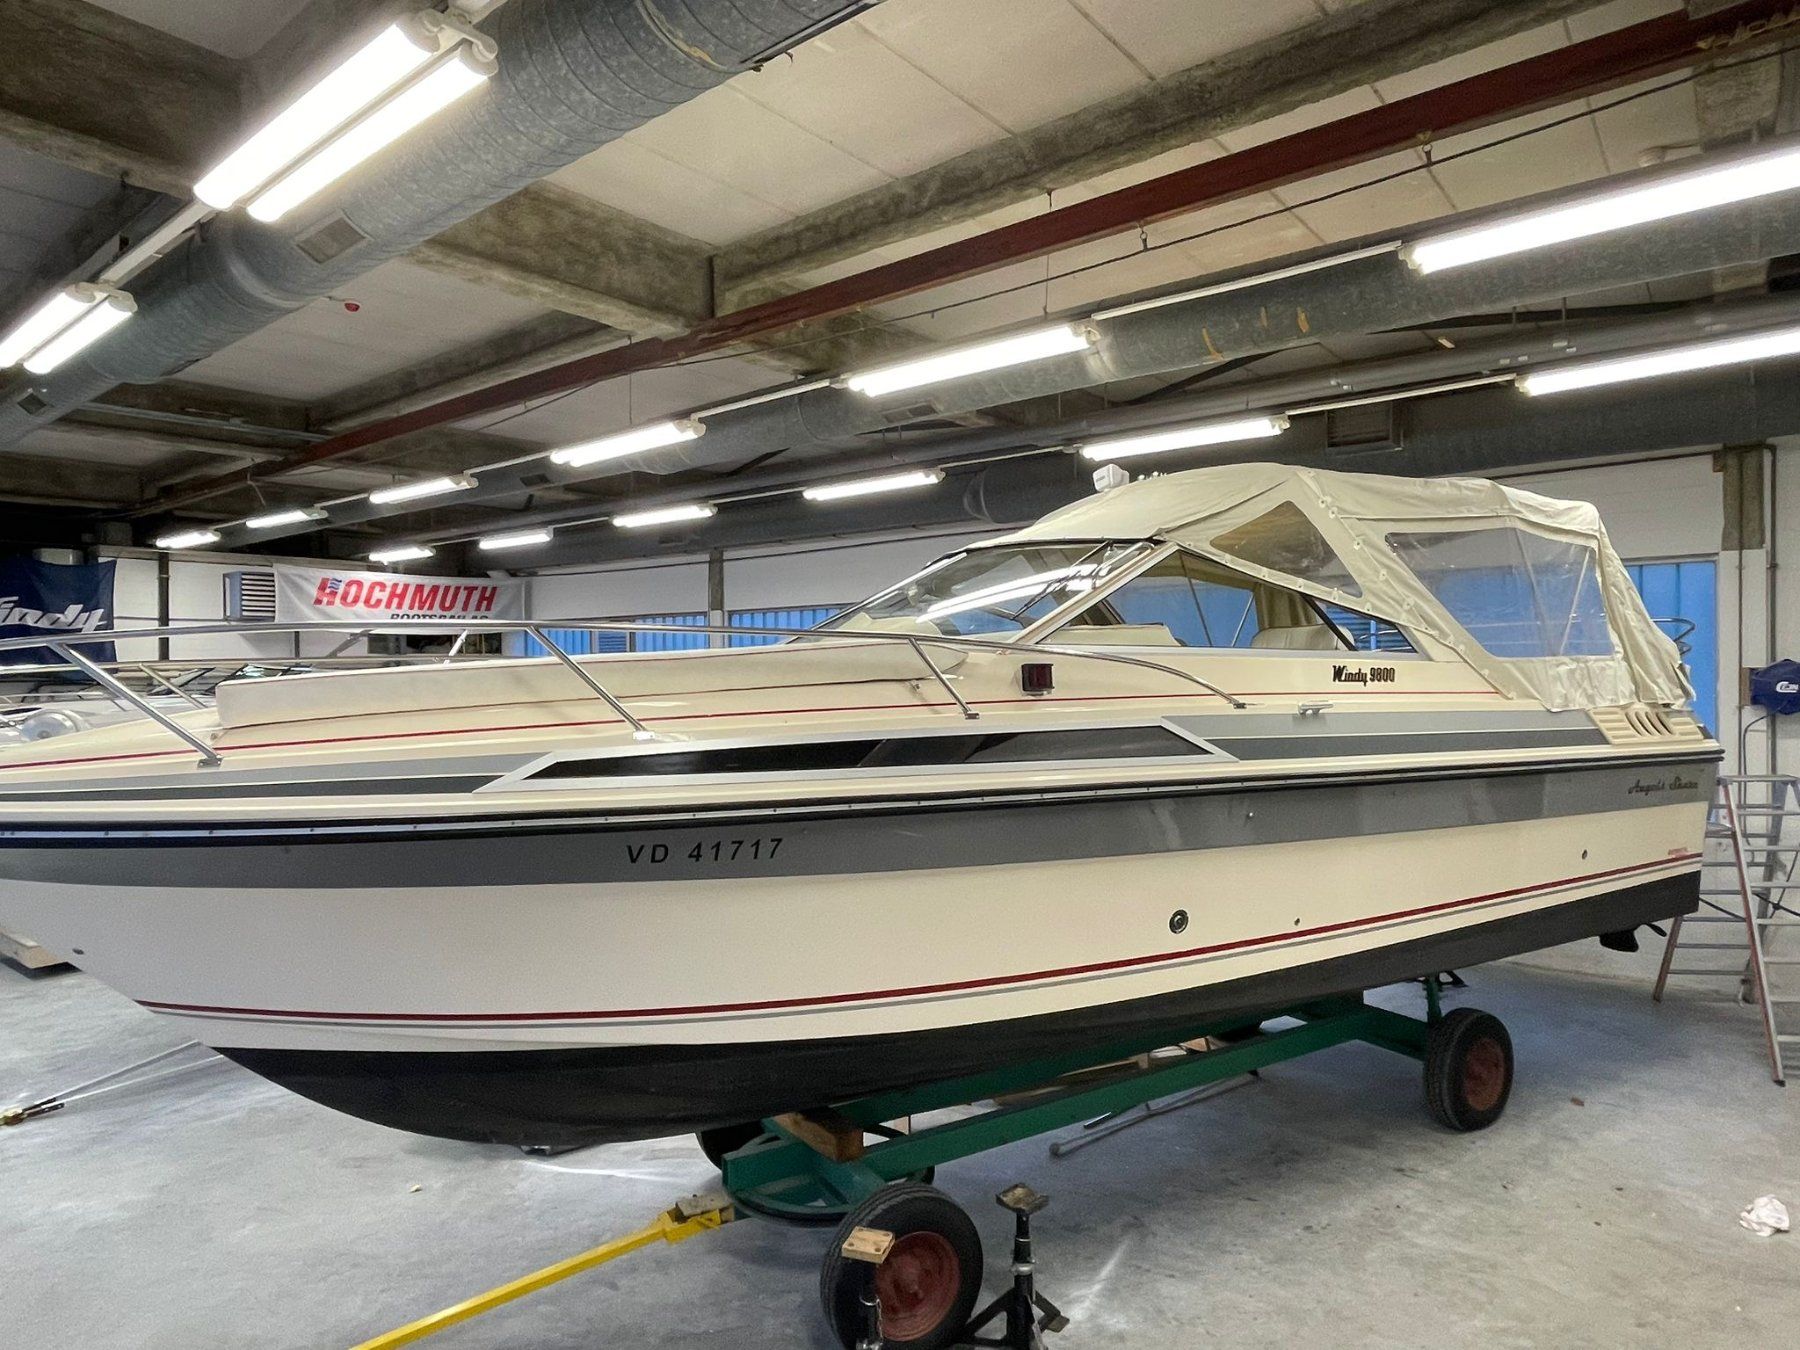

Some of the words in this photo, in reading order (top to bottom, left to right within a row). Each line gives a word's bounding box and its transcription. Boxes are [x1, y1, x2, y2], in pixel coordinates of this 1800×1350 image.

[313, 577, 498, 612] HOCHMUTH
[0, 596, 107, 633] indy
[1332, 665, 1368, 687] Windy
[1369, 667, 1396, 683] 9800
[626, 844, 669, 864] VD
[688, 838, 783, 862] 41717
